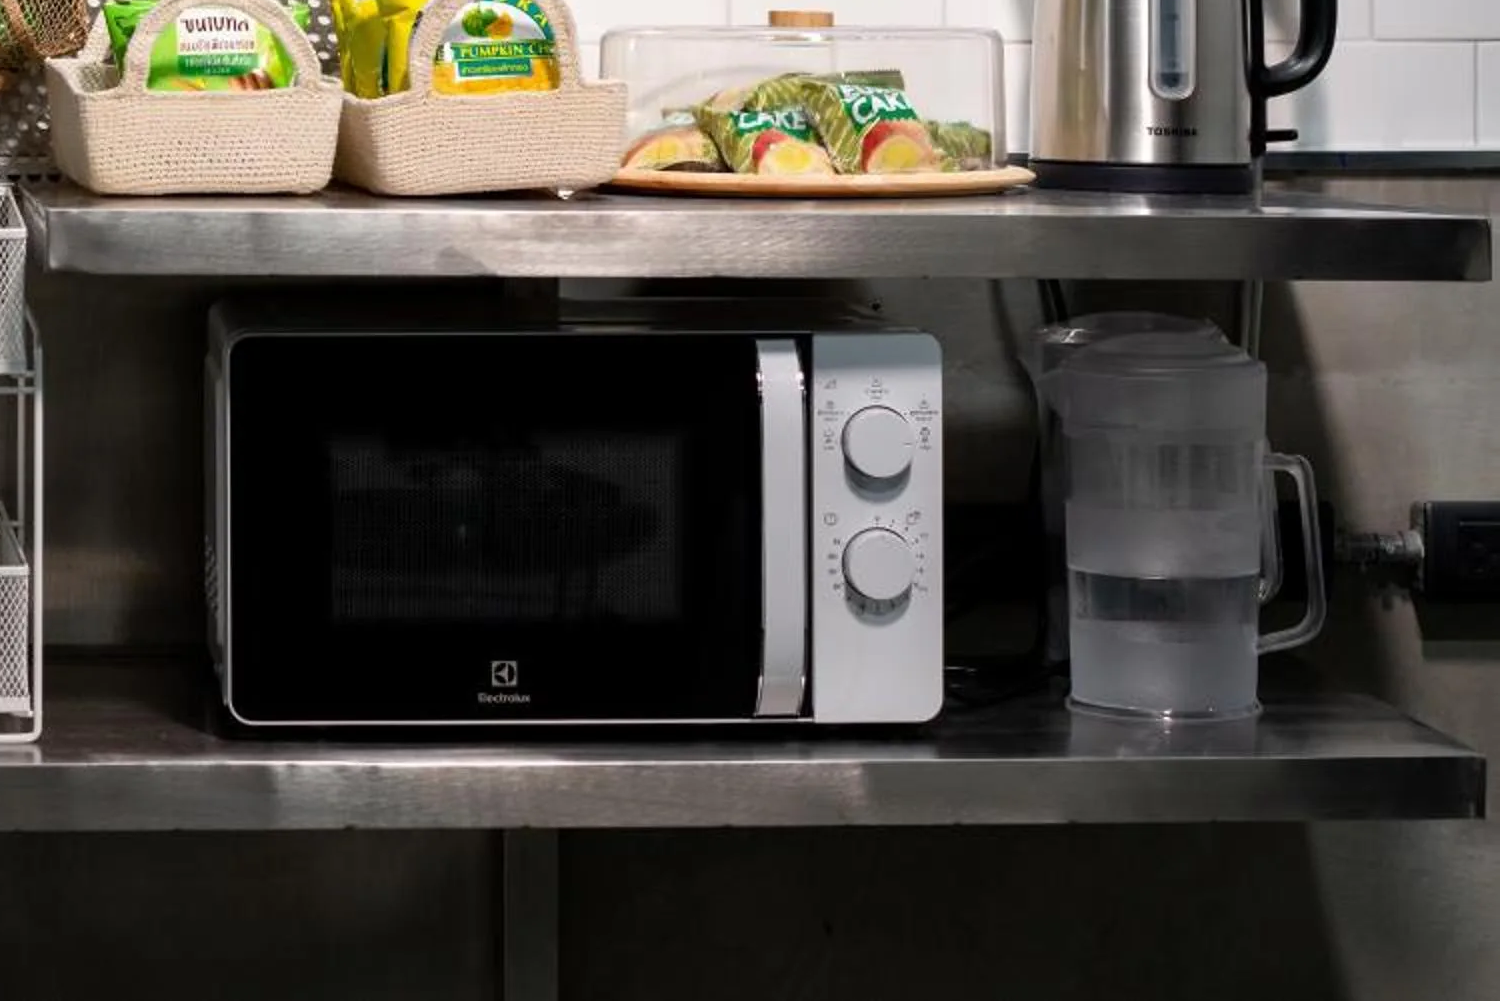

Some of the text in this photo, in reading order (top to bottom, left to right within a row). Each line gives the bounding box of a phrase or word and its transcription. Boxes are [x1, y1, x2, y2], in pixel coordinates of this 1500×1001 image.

[460, 44, 525, 58] PUMPKIN
[1145, 126, 1198, 137] TOSHIBA
[477, 692, 531, 705] Electrolux
